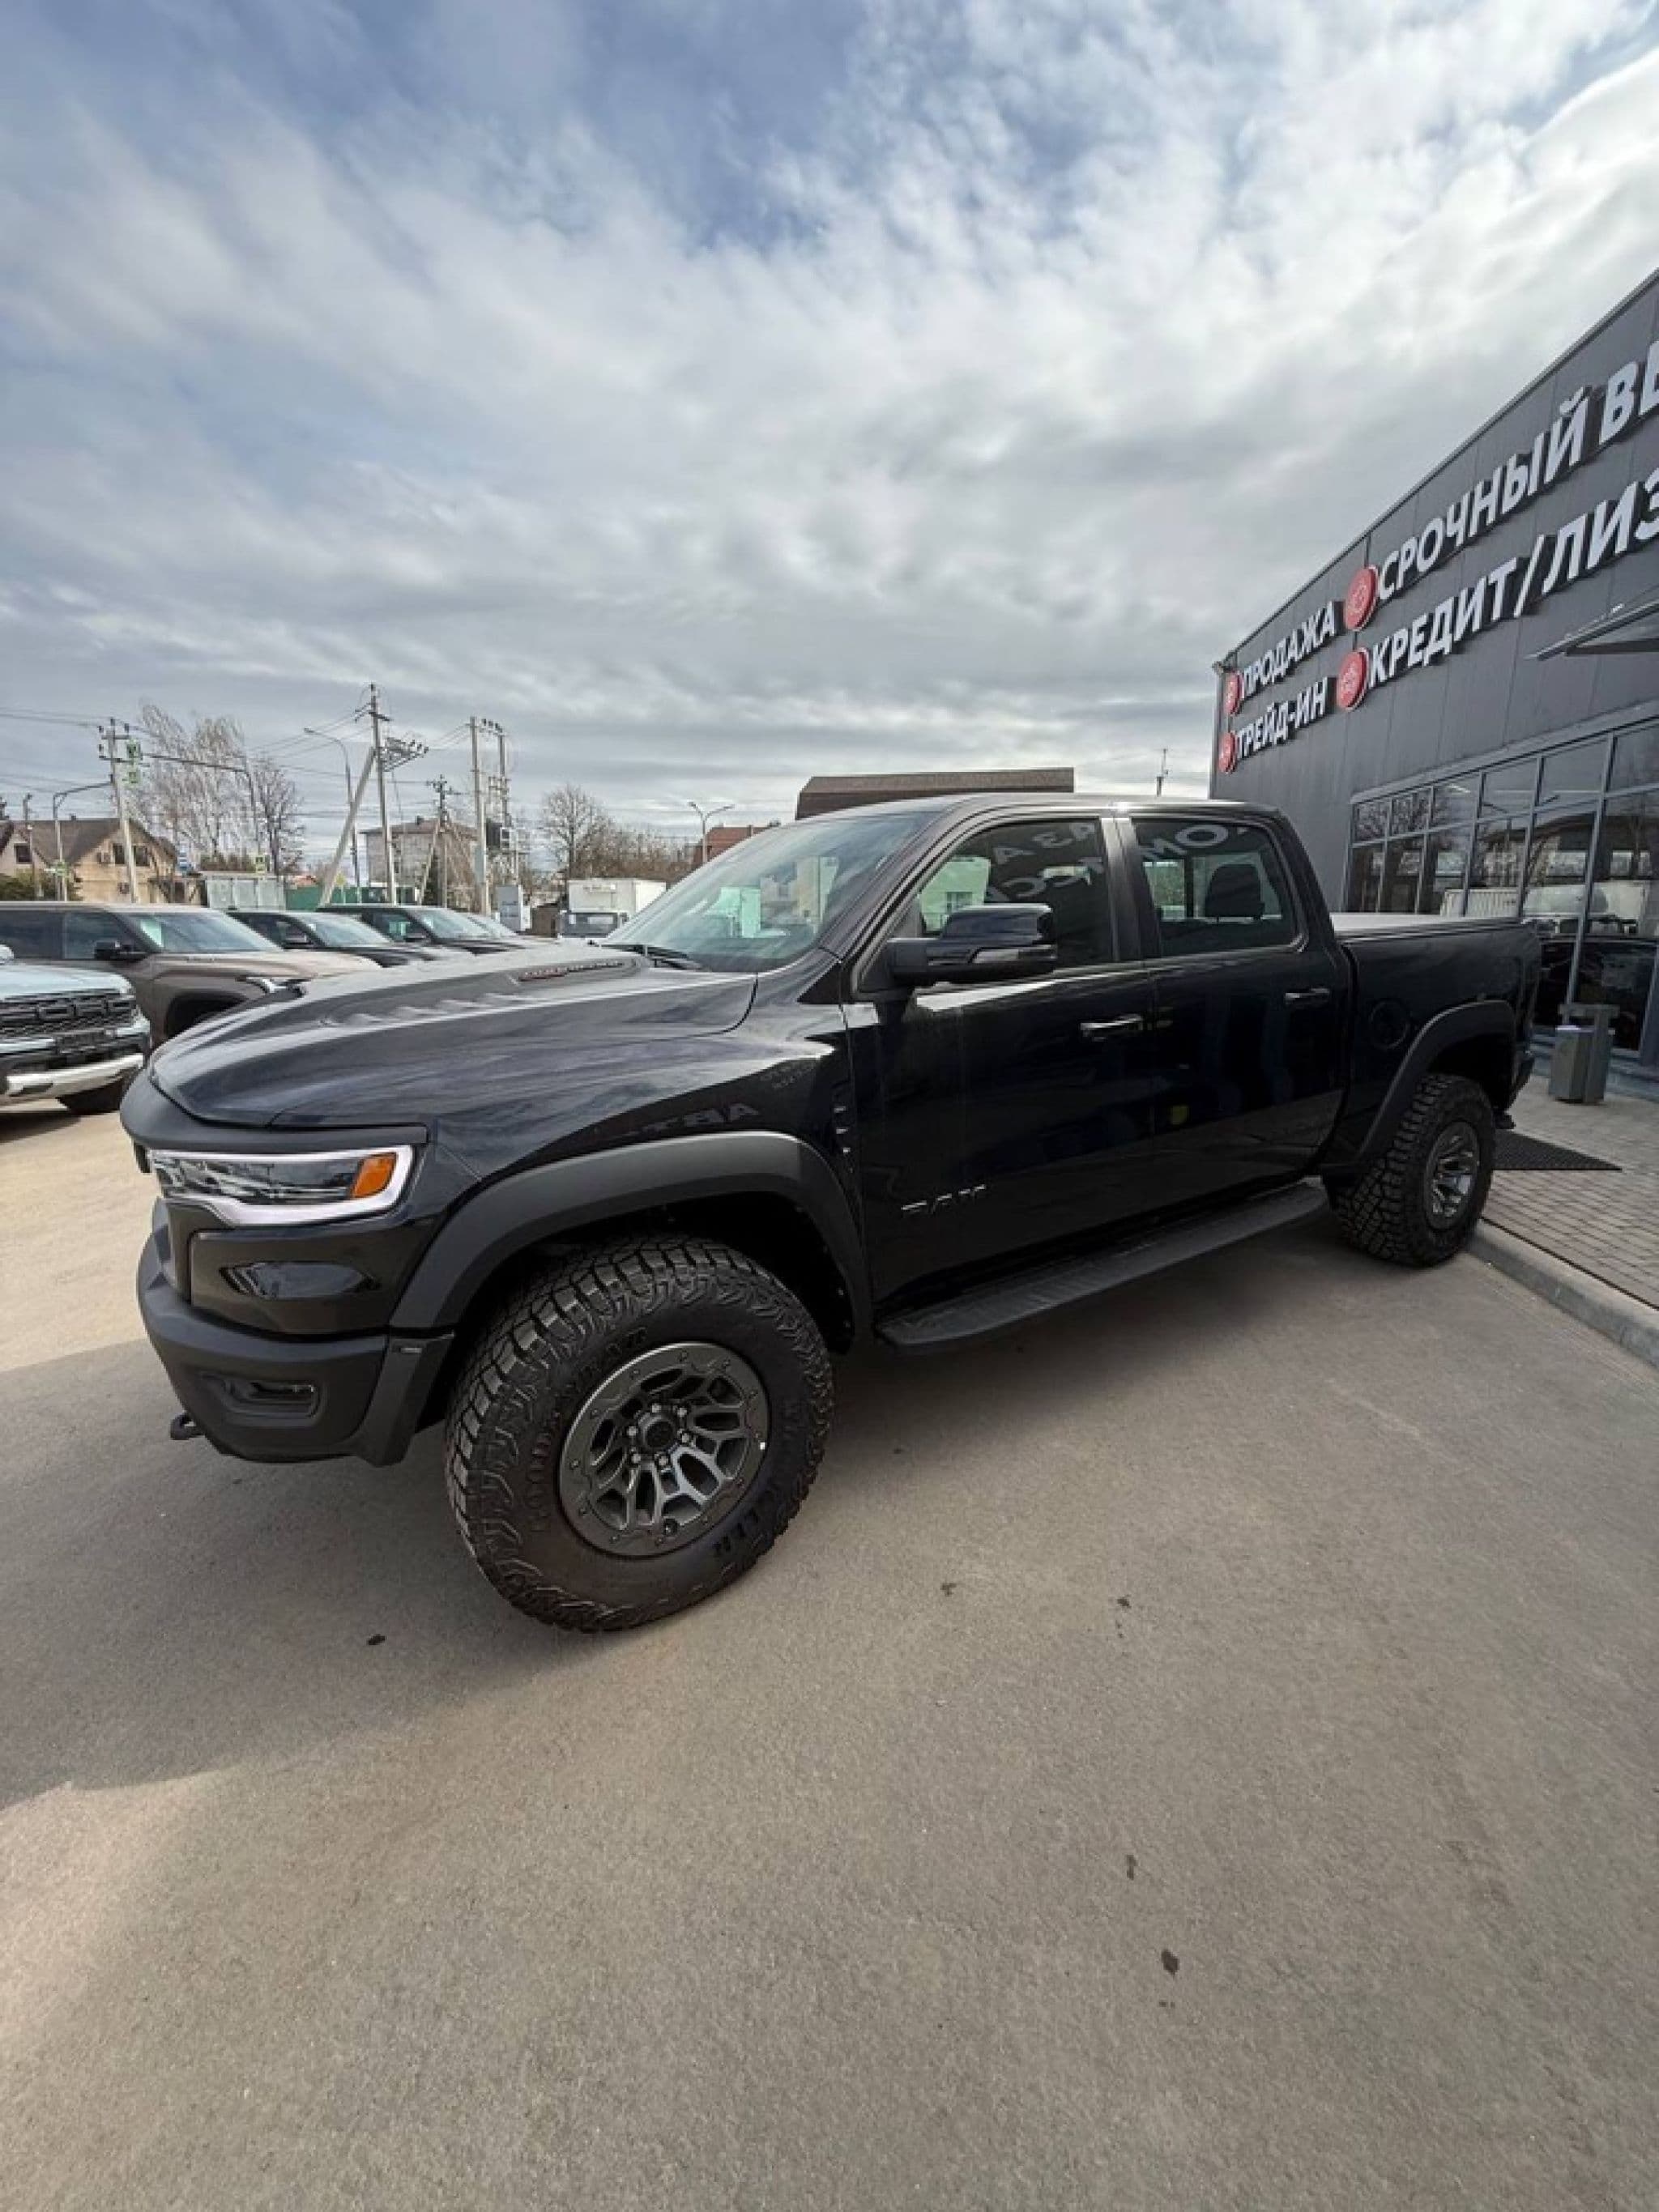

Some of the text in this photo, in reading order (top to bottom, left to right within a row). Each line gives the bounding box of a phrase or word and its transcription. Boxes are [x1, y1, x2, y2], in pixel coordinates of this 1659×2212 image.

[1378, 386, 1589, 600] СРОЧНЫЙ
[1242, 600, 1335, 699] ПРОДАЖА
[1236, 676, 1328, 759] ТРЕЙД-ИН
